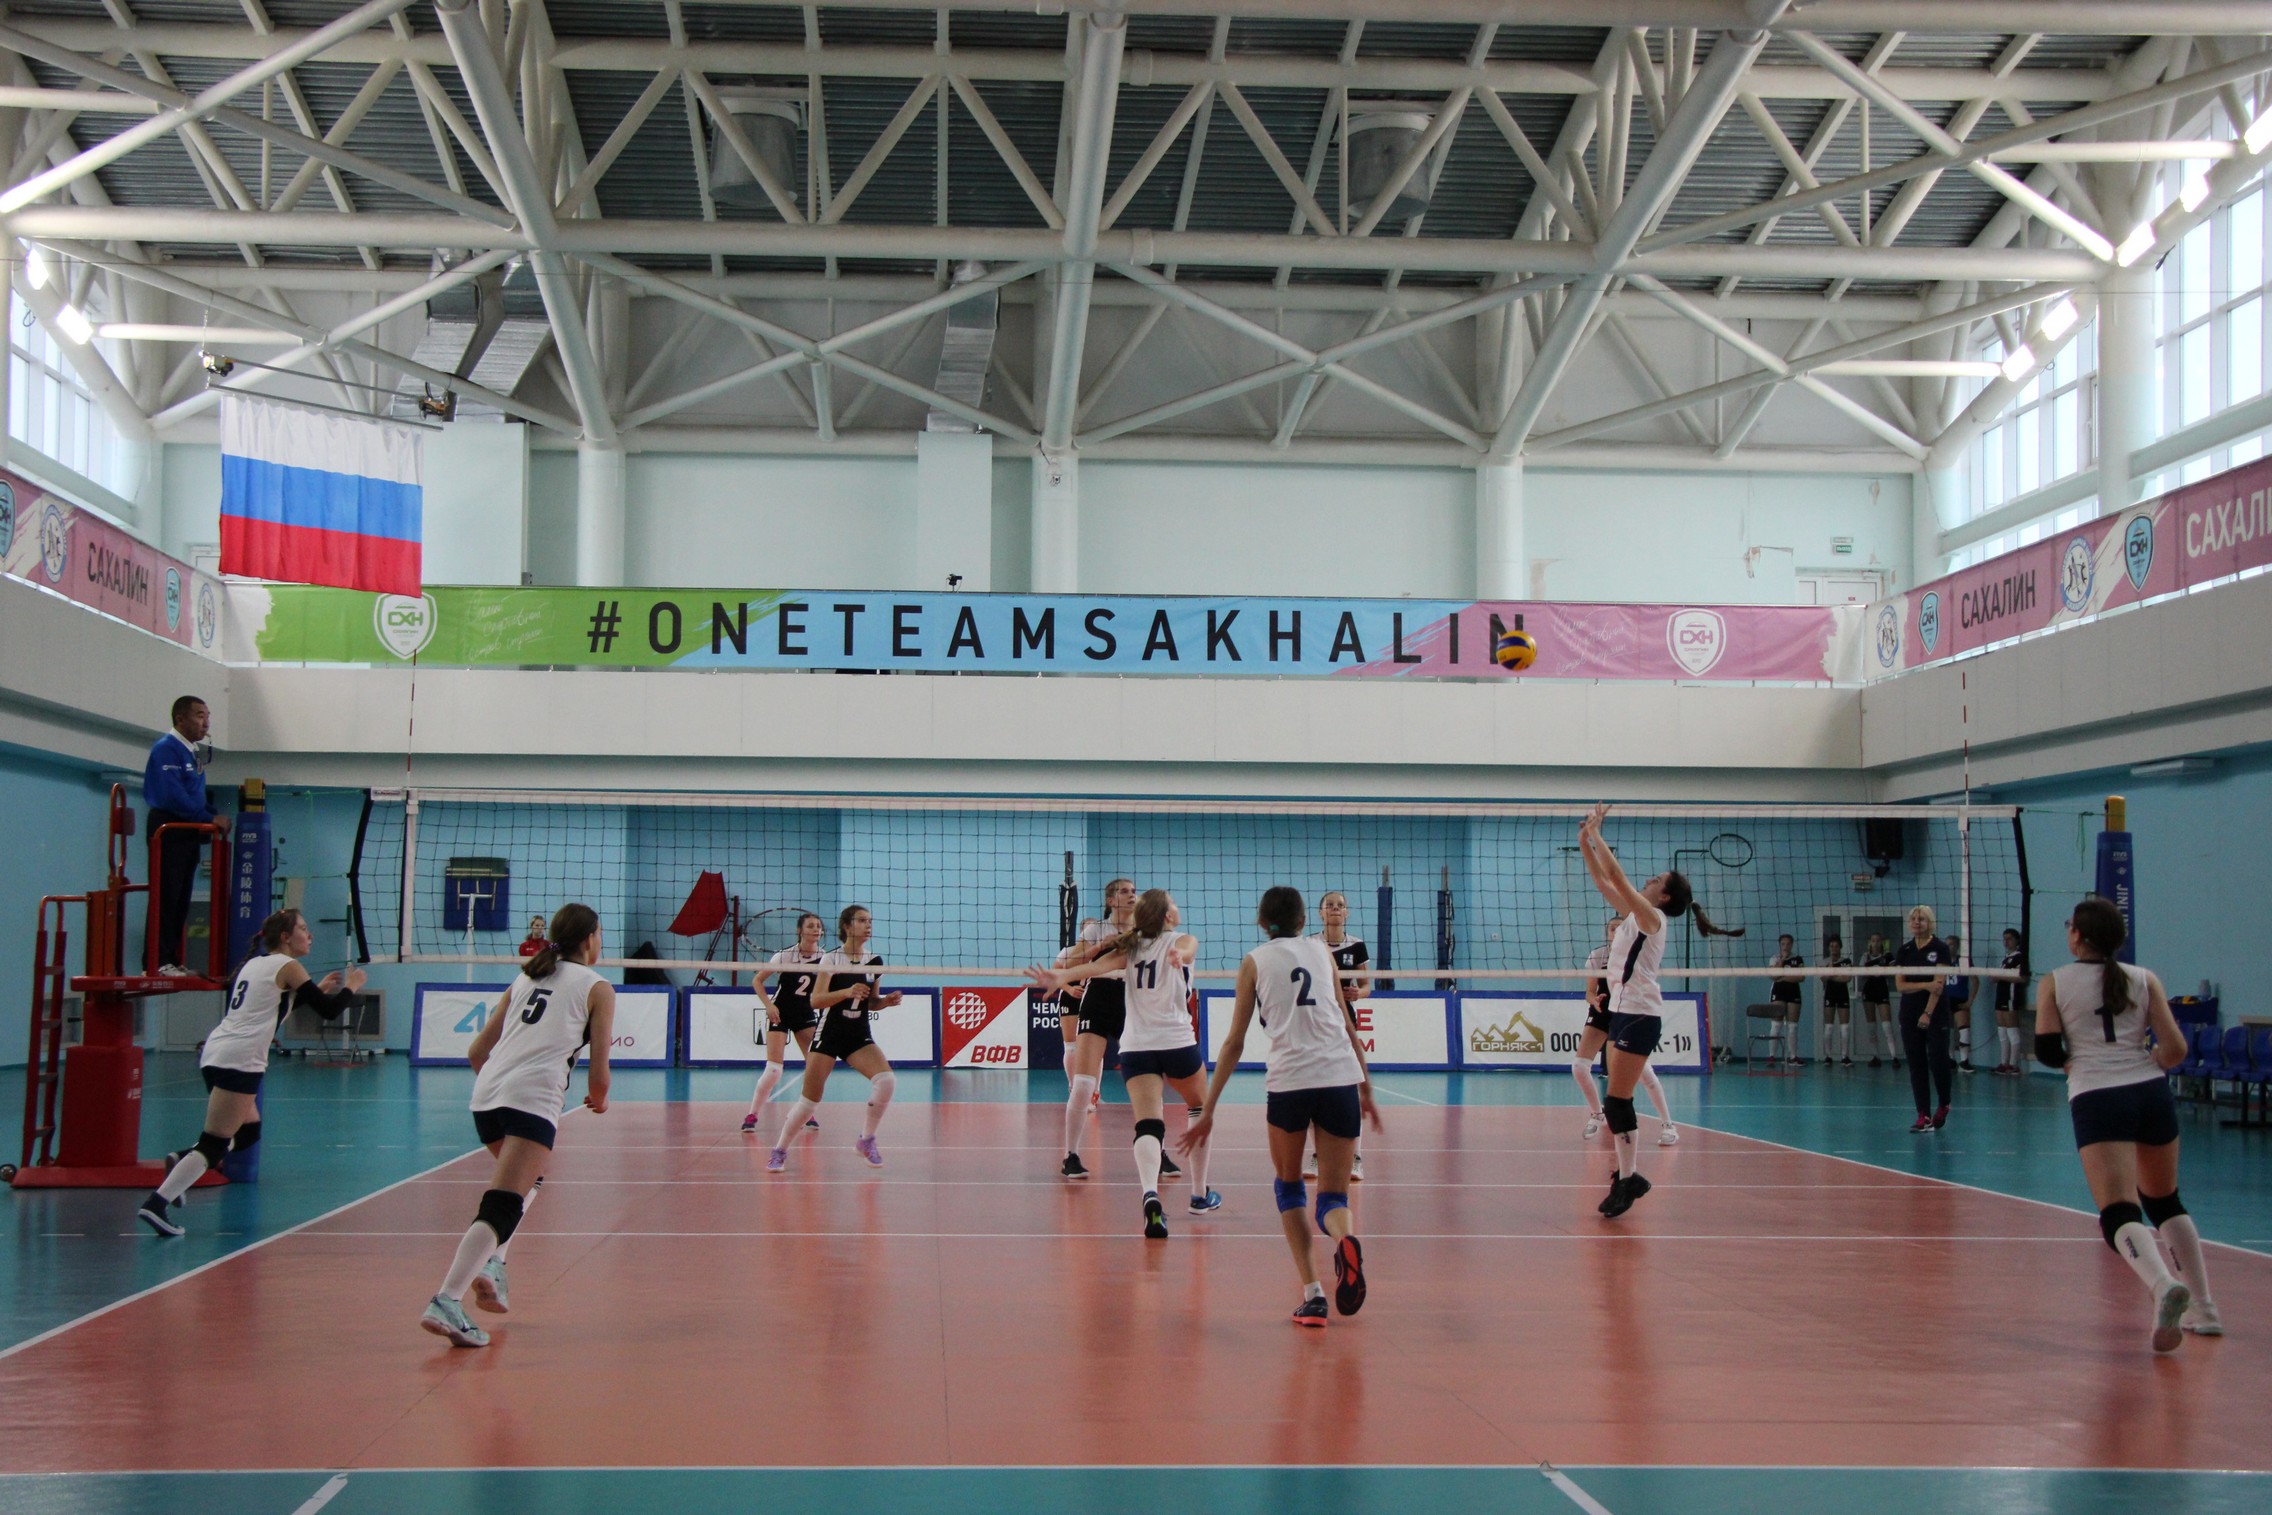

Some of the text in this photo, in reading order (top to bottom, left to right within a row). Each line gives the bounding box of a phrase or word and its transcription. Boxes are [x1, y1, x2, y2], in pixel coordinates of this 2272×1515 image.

[2186, 487, 2272, 558] САХАЛ
[87, 541, 149, 606] САХАЛИН
[1961, 569, 2036, 629] САХАЛИН
[586, 601, 1524, 665] #ONETEAMSAKHALIN
[795, 975, 811, 996] 2
[1134, 960, 1157, 989] 11
[1290, 967, 1317, 1006] 2
[231, 980, 249, 1010] 3
[521, 988, 553, 1025] 5
[2095, 1003, 2117, 1043] 1
[971, 1045, 1022, 1064] ВФВ
[1472, 1040, 1544, 1052] ГОРНЯК-1
